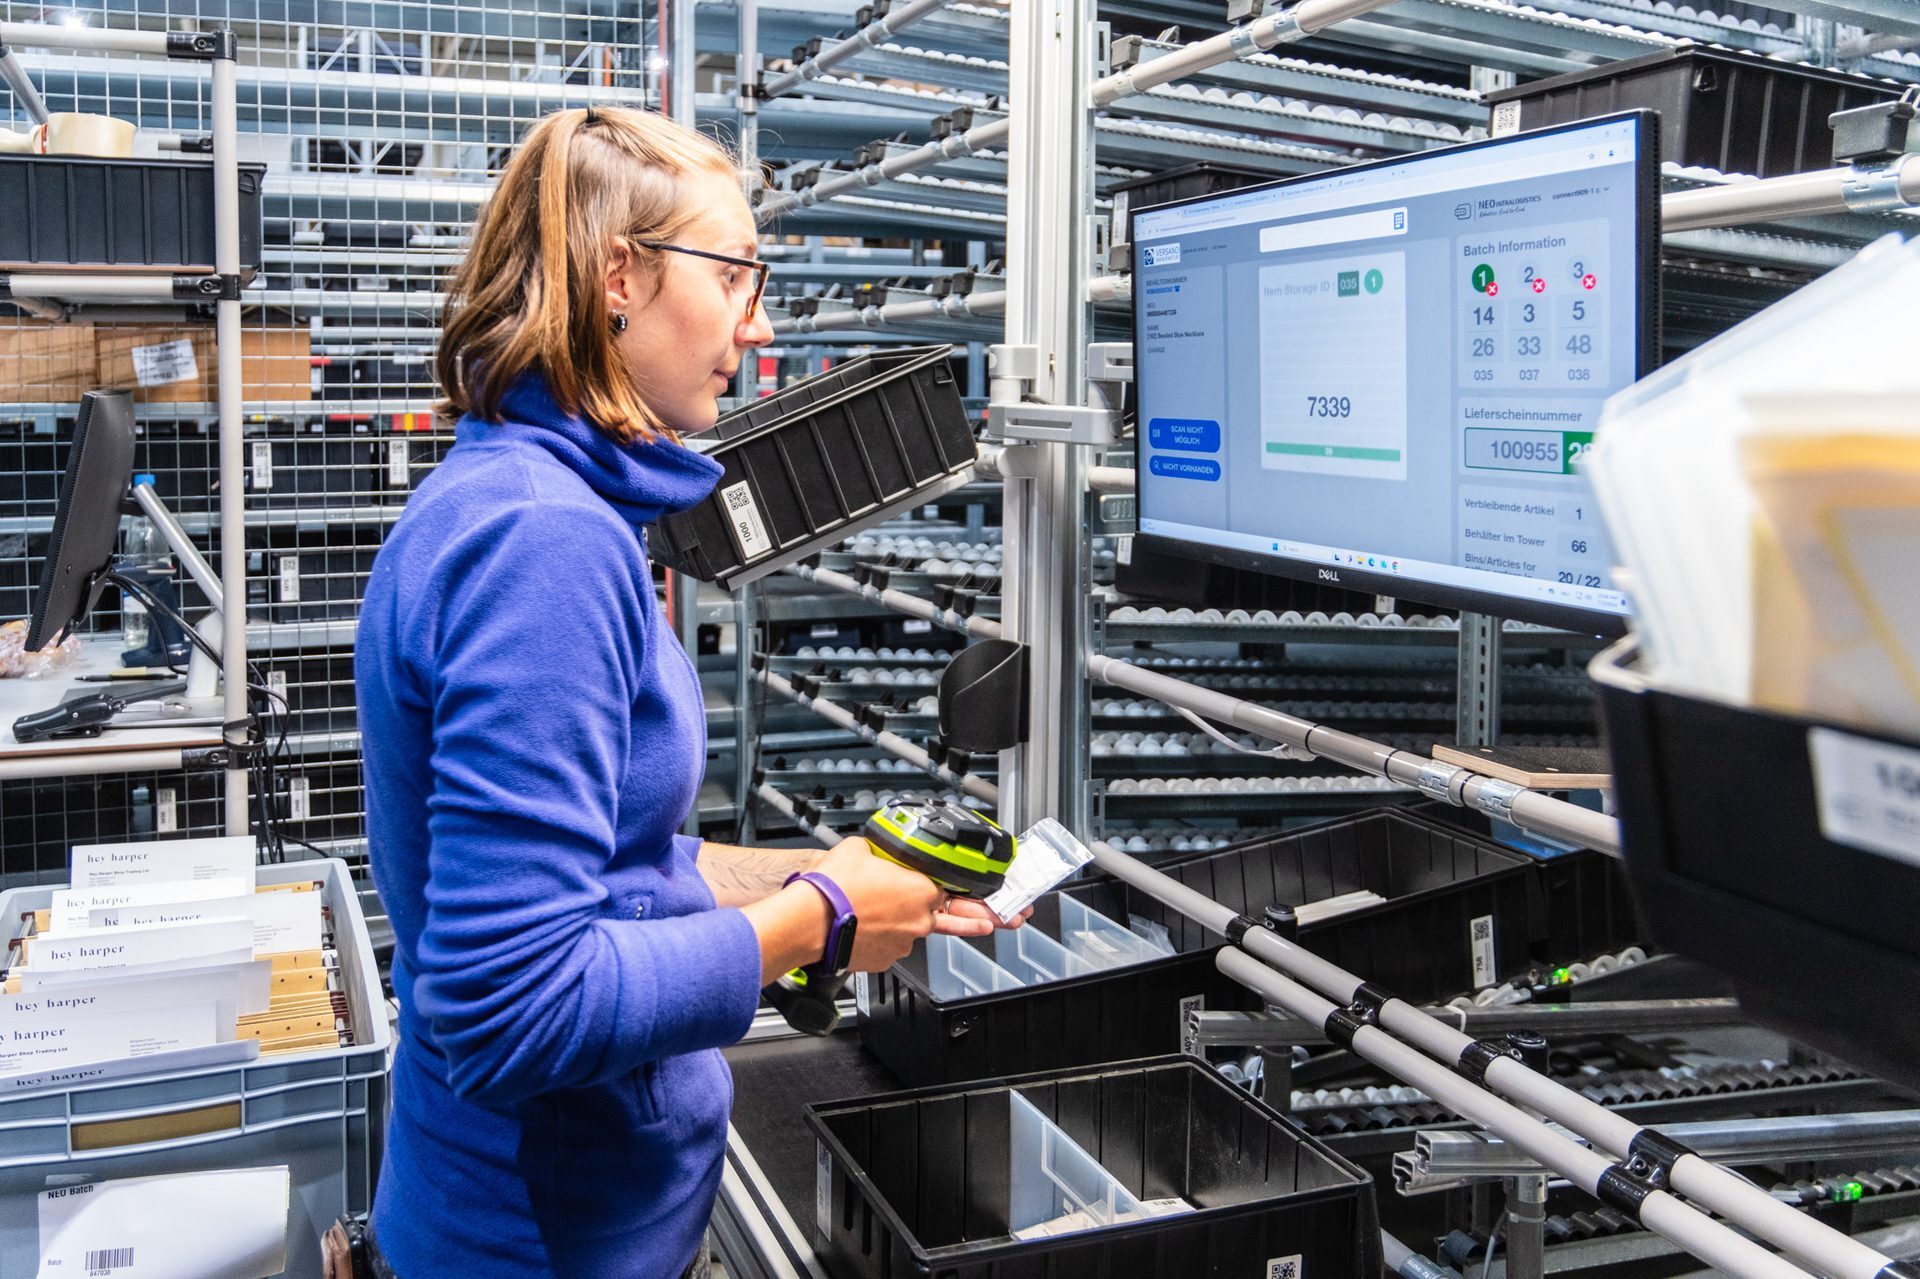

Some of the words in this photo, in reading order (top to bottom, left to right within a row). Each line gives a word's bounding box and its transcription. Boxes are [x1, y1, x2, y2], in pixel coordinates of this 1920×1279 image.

[1478, 199, 1495, 210] NEO
[1464, 242, 1495, 256] Batch
[1499, 236, 1566, 254] Information
[1478, 270, 1486, 286] 1
[1524, 266, 1534, 282] 2
[1573, 262, 1584, 278] 3
[1264, 286, 1282, 296] Item
[1284, 282, 1318, 296] Storage
[1320, 280, 1330, 292] ID
[1340, 278, 1358, 290] 035
[1370, 276, 1376, 288] 1
[1473, 306, 1494, 326] 14
[1523, 304, 1535, 322] 3
[1572, 300, 1585, 320] 5
[1472, 338, 1494, 357] 26
[1518, 336, 1541, 356] 33
[1566, 334, 1592, 354] 48
[1474, 370, 1494, 380] 035
[1520, 369, 1540, 380] 037
[1568, 368, 1590, 380] 038
[1307, 396, 1350, 418] 7339
[1464, 408, 1582, 422] Lieferscheinnummer
[1170, 425, 1186, 434] SCAN
[1187, 426, 1204, 434] NICHT
[1174, 436, 1200, 445] MÖGLICH
[1491, 440, 1558, 461] 100955
[1162, 462, 1178, 470] NICHT
[1180, 464, 1214, 474] VORHANDEN
[1464, 498, 1522, 513] Verbleibende
[1524, 504, 1555, 516] Artikel
[1576, 508, 1582, 520] 1
[740, 522, 752, 543] 1000
[1465, 528, 1502, 541] Behälter
[1504, 532, 1515, 544] im
[1518, 534, 1545, 547] Tower
[1572, 540, 1587, 554] 66
[1465, 552, 1521, 570] Bins/Articles
[1523, 560, 1536, 572] for
[1318, 568, 1340, 581] DELL
[1558, 572, 1574, 584] 20
[1585, 575, 1600, 588] 22
[87, 854, 105, 864] hey
[112, 852, 149, 862] harper
[66, 898, 86, 908] hey
[92, 896, 132, 906] harper
[51, 950, 74, 961] hey
[80, 945, 124, 957] harper
[15, 1002, 40, 1012] hey
[47, 996, 96, 1008] harper
[14, 1028, 66, 1040] harper
[51, 1068, 104, 1081] harper
[70, 1184, 94, 1196] Batch
